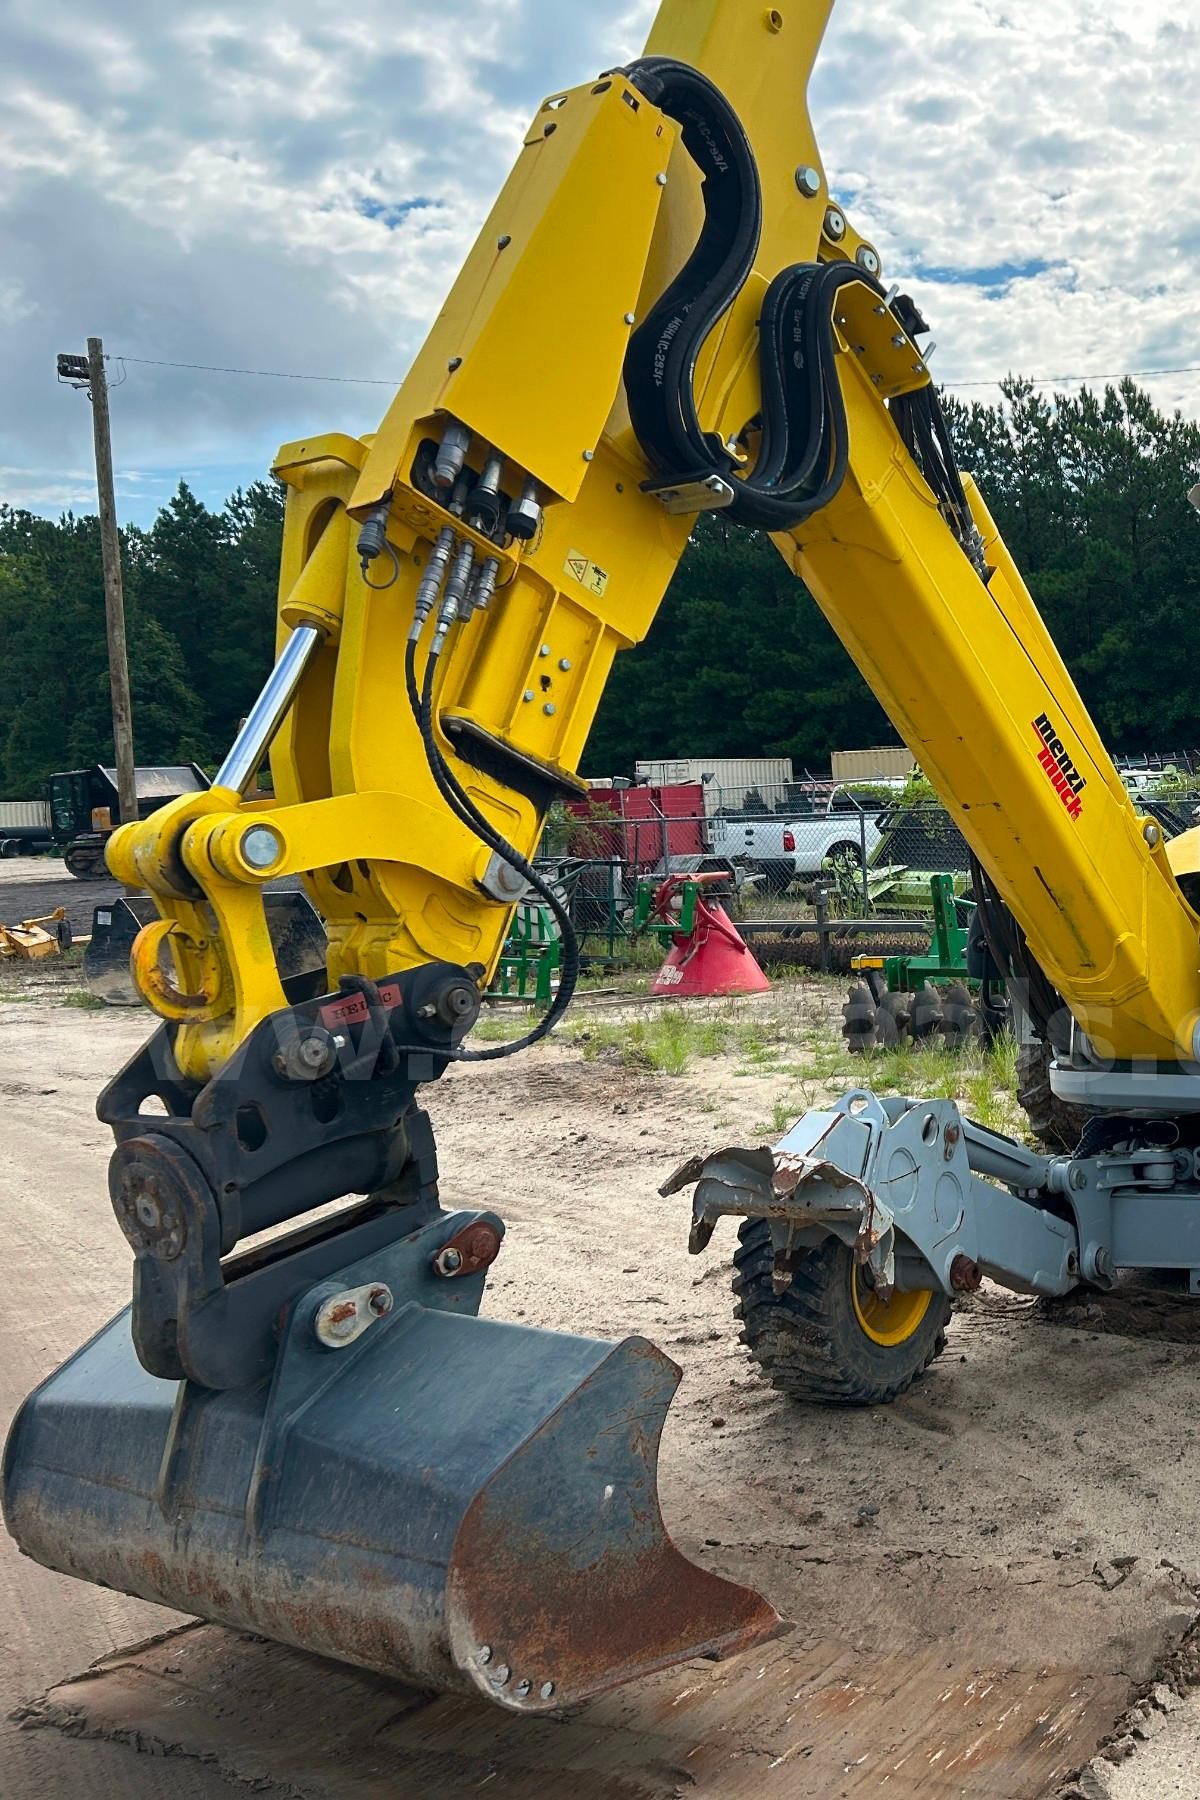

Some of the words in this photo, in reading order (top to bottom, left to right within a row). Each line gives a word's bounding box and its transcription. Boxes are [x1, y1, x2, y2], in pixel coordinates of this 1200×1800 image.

[1034, 711, 1087, 795] menzi
[1036, 748, 1084, 817] muck
[332, 992, 393, 1019] HELC
